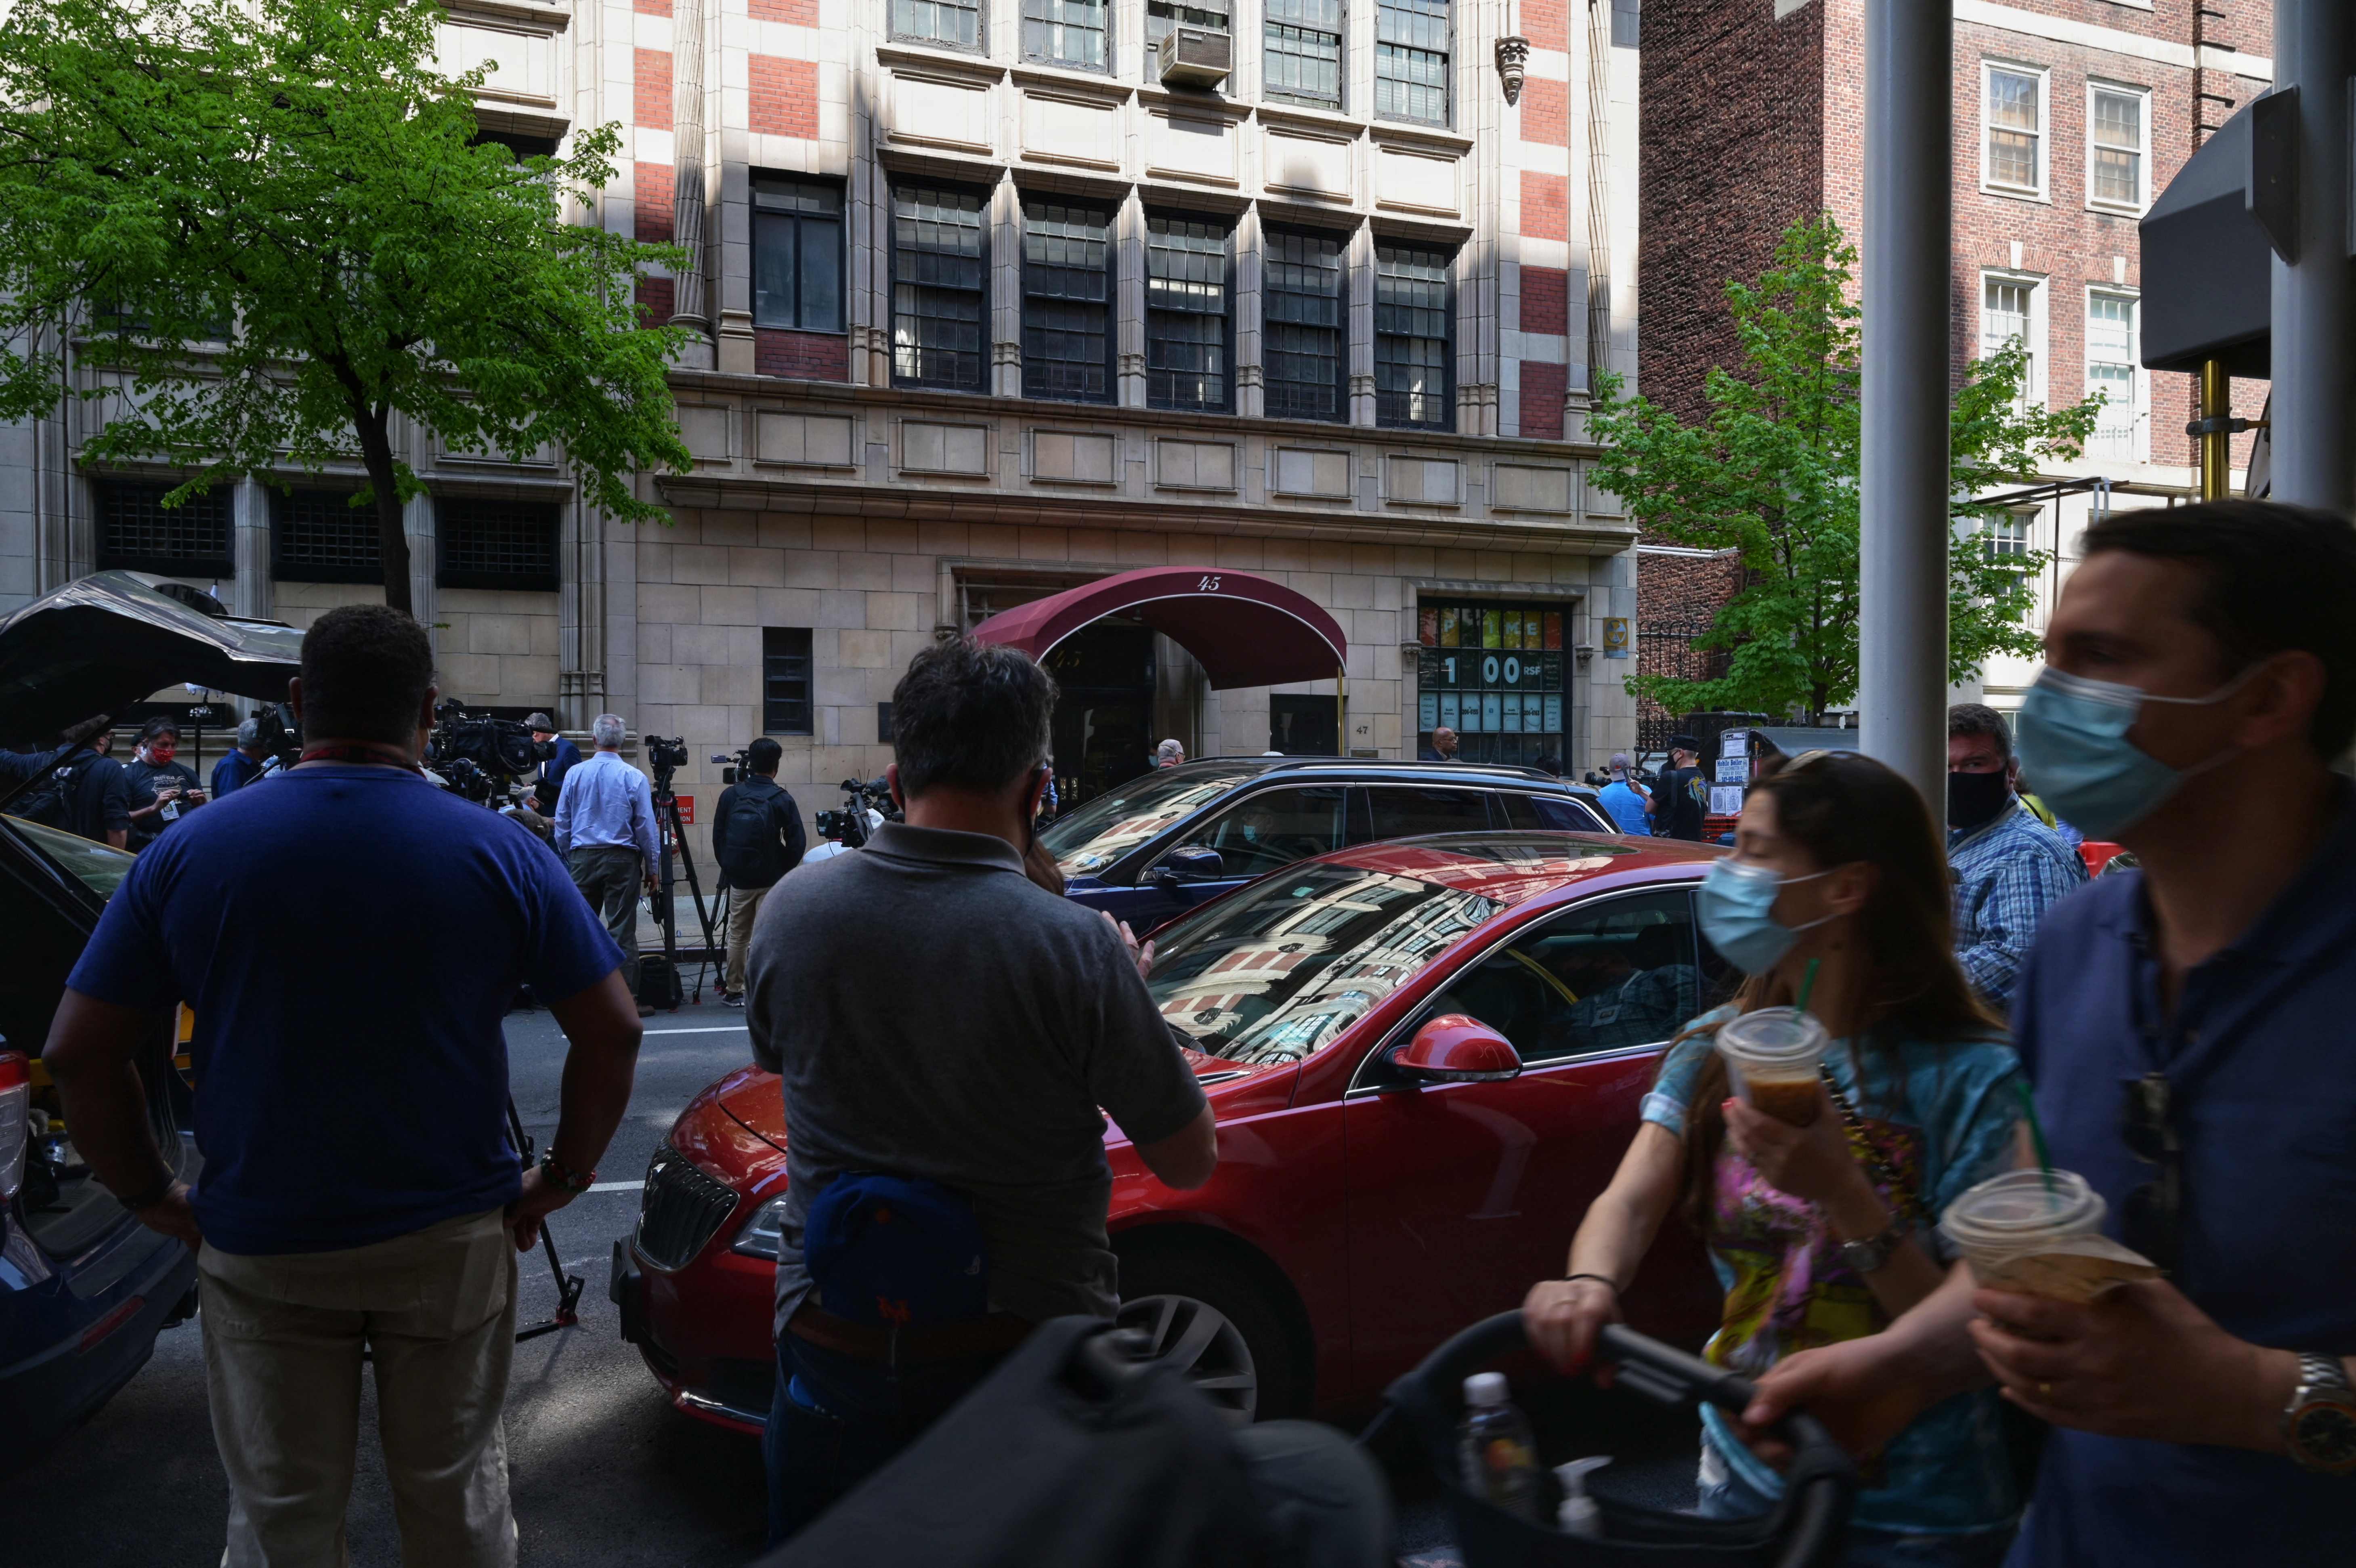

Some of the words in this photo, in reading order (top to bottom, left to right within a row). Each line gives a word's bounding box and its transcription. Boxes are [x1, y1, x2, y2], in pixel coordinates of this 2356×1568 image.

[1197, 576, 1221, 591] 45
[1444, 619, 1538, 636] PIME
[1445, 656, 1520, 684] 100
[1523, 666, 1540, 676] RSF
[1356, 726, 1368, 734] 47
